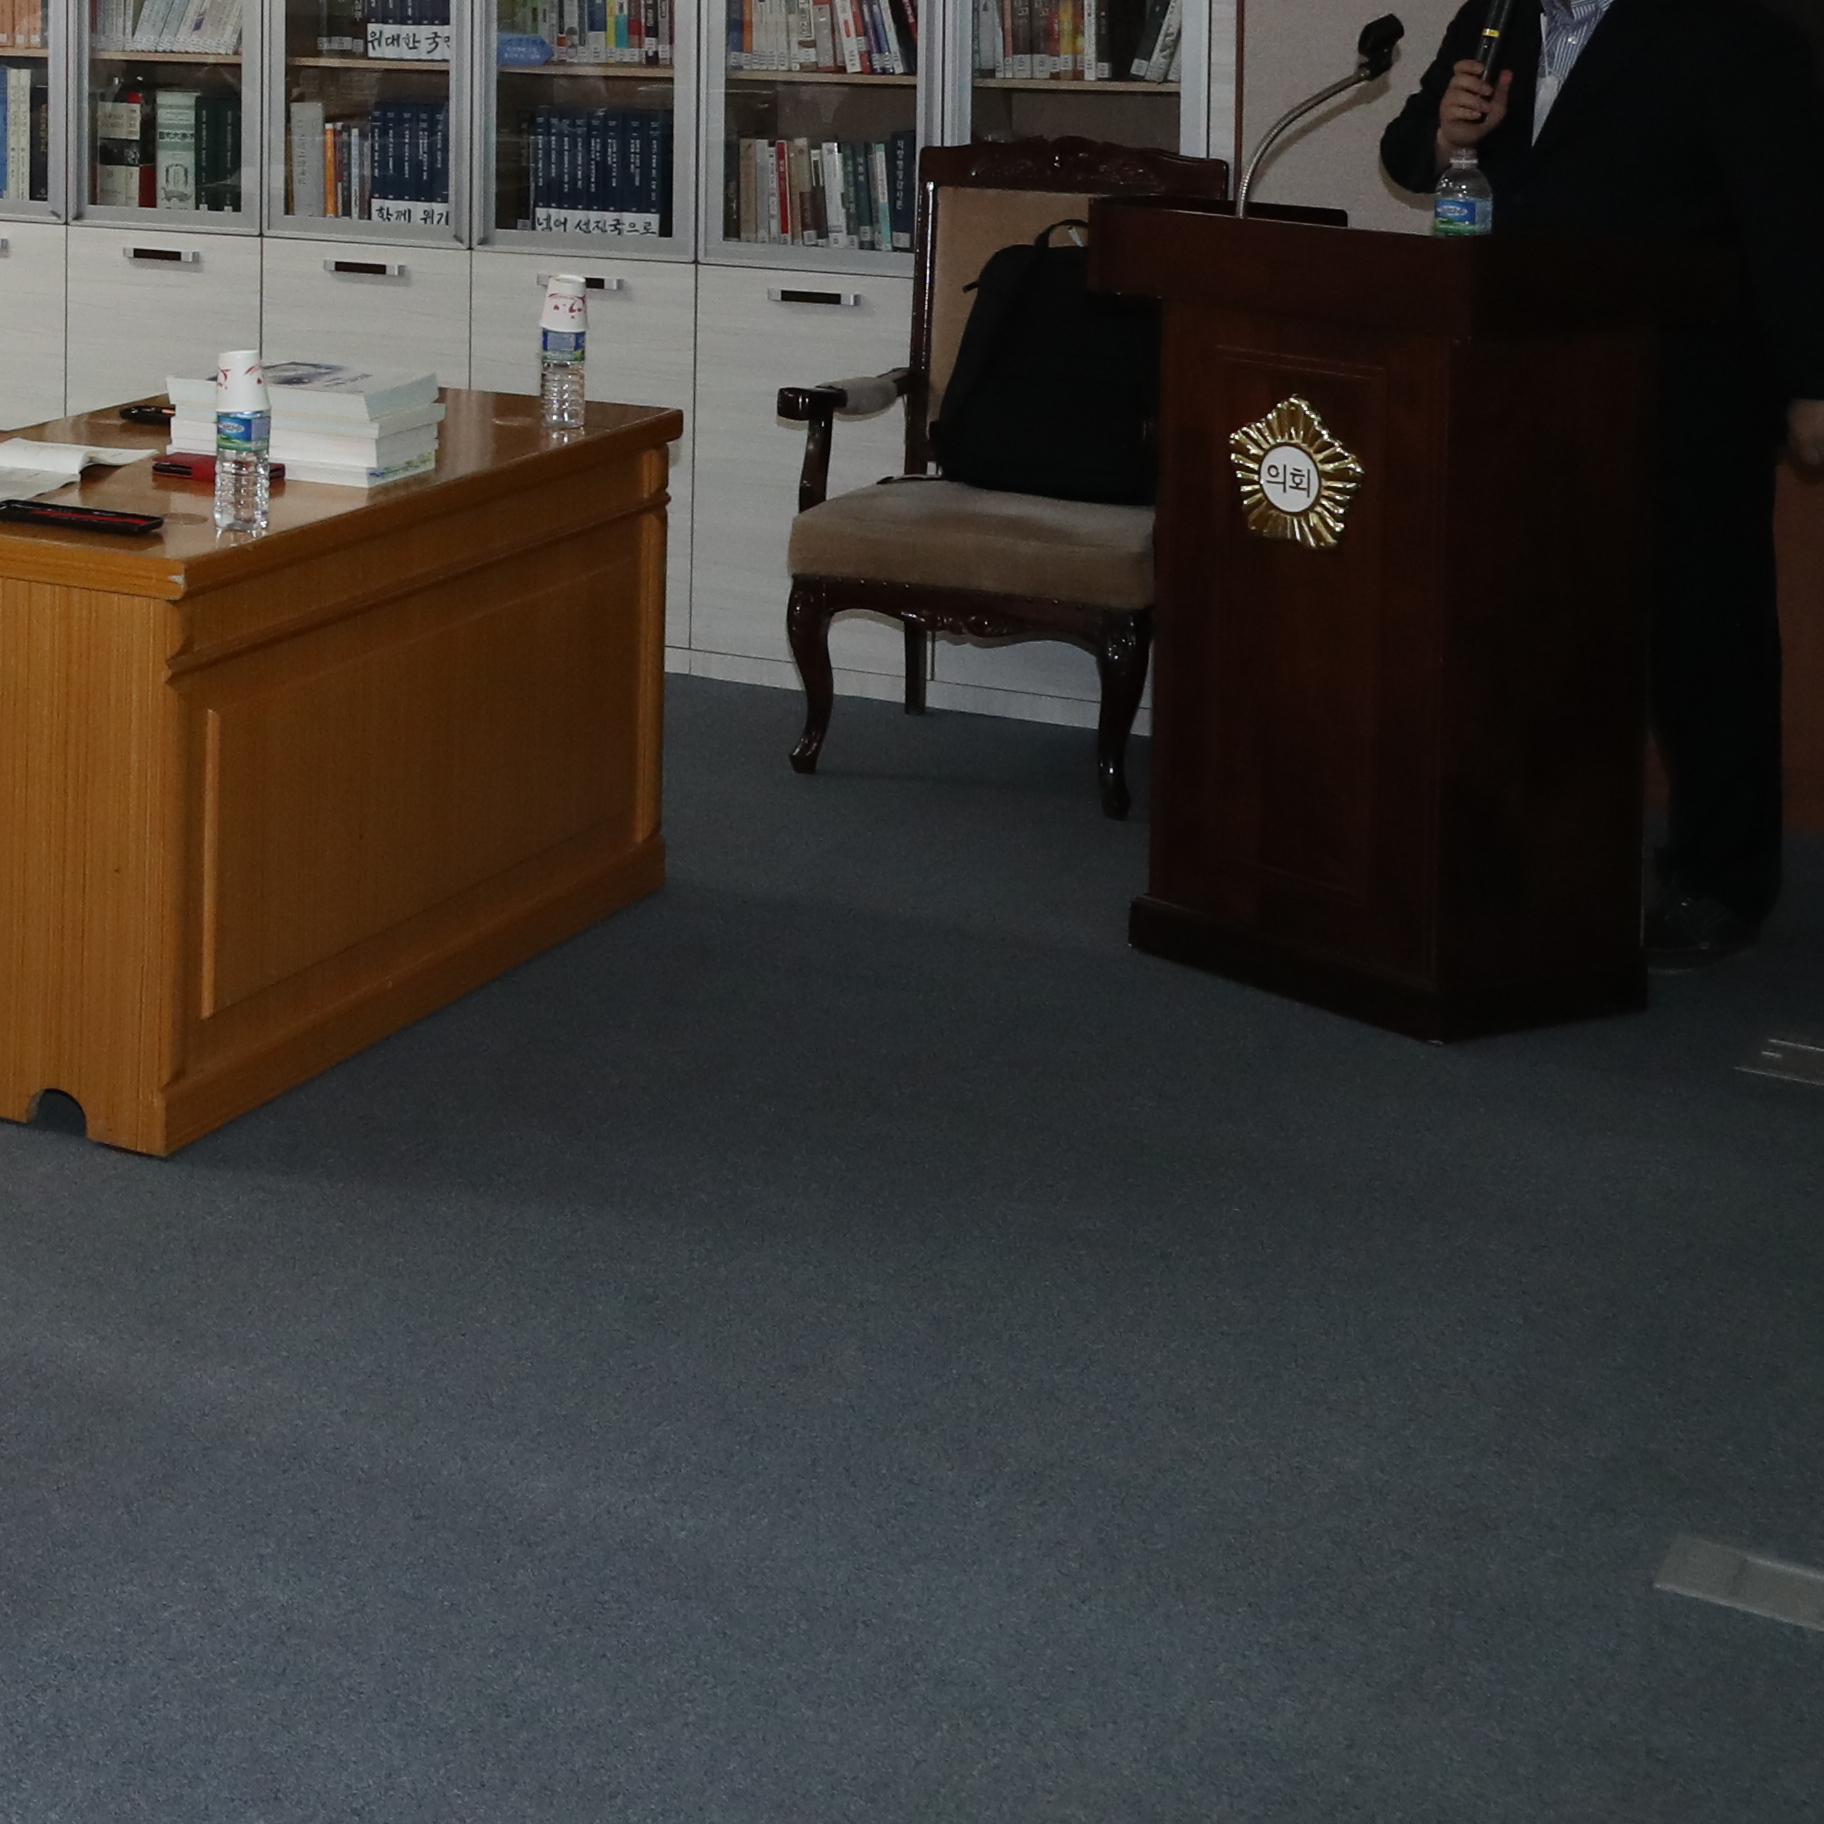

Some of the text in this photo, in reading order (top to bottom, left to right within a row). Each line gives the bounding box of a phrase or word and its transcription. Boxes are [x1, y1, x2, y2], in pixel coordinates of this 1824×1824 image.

[367, 30, 421, 51] 위대한
[375, 205, 449, 226] 함께 위기
[574, 218, 657, 235] 선진국으로
[1266, 463, 1311, 498] 의회
